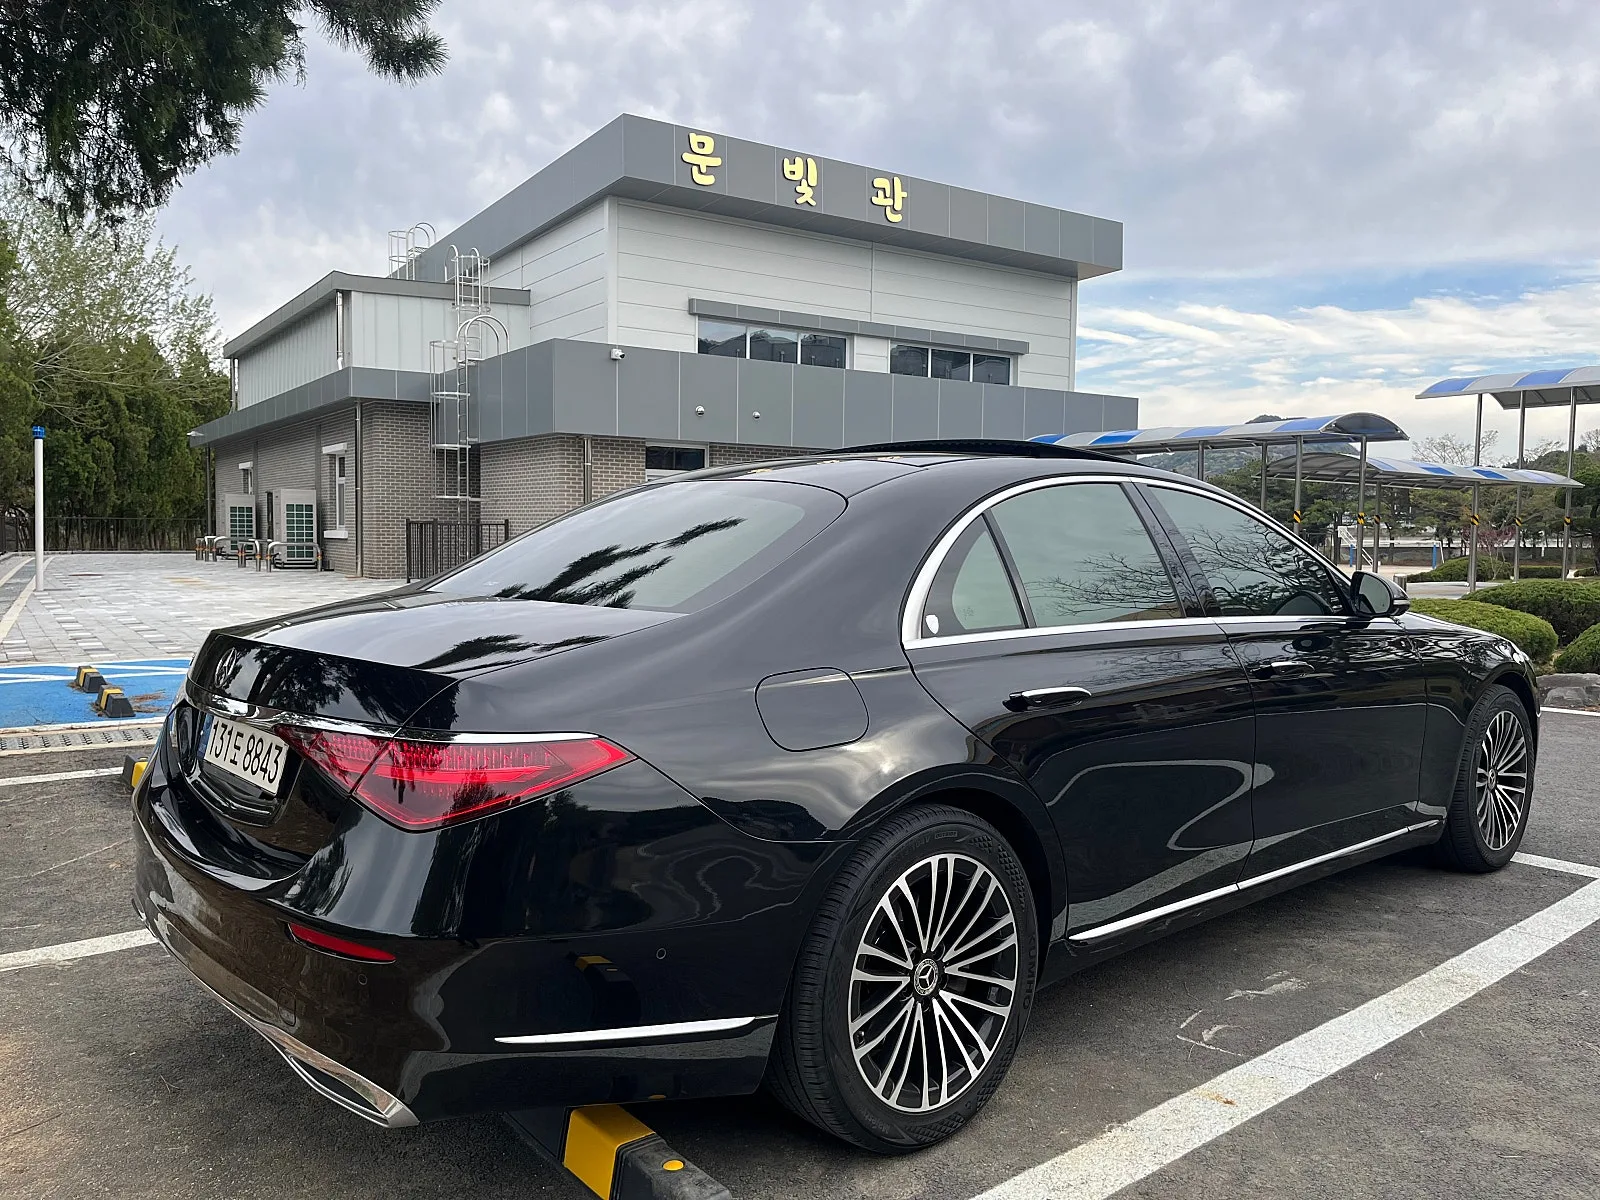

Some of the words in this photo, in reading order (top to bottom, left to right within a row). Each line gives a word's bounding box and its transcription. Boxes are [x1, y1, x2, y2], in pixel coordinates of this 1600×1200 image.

[681, 132, 722, 186] 문
[782, 156, 818, 207] 빛
[871, 176, 908, 223] 관
[209, 720, 244, 766] 131도
[242, 734, 283, 784] 8843
[1023, 933, 1037, 1010] KUMHO
